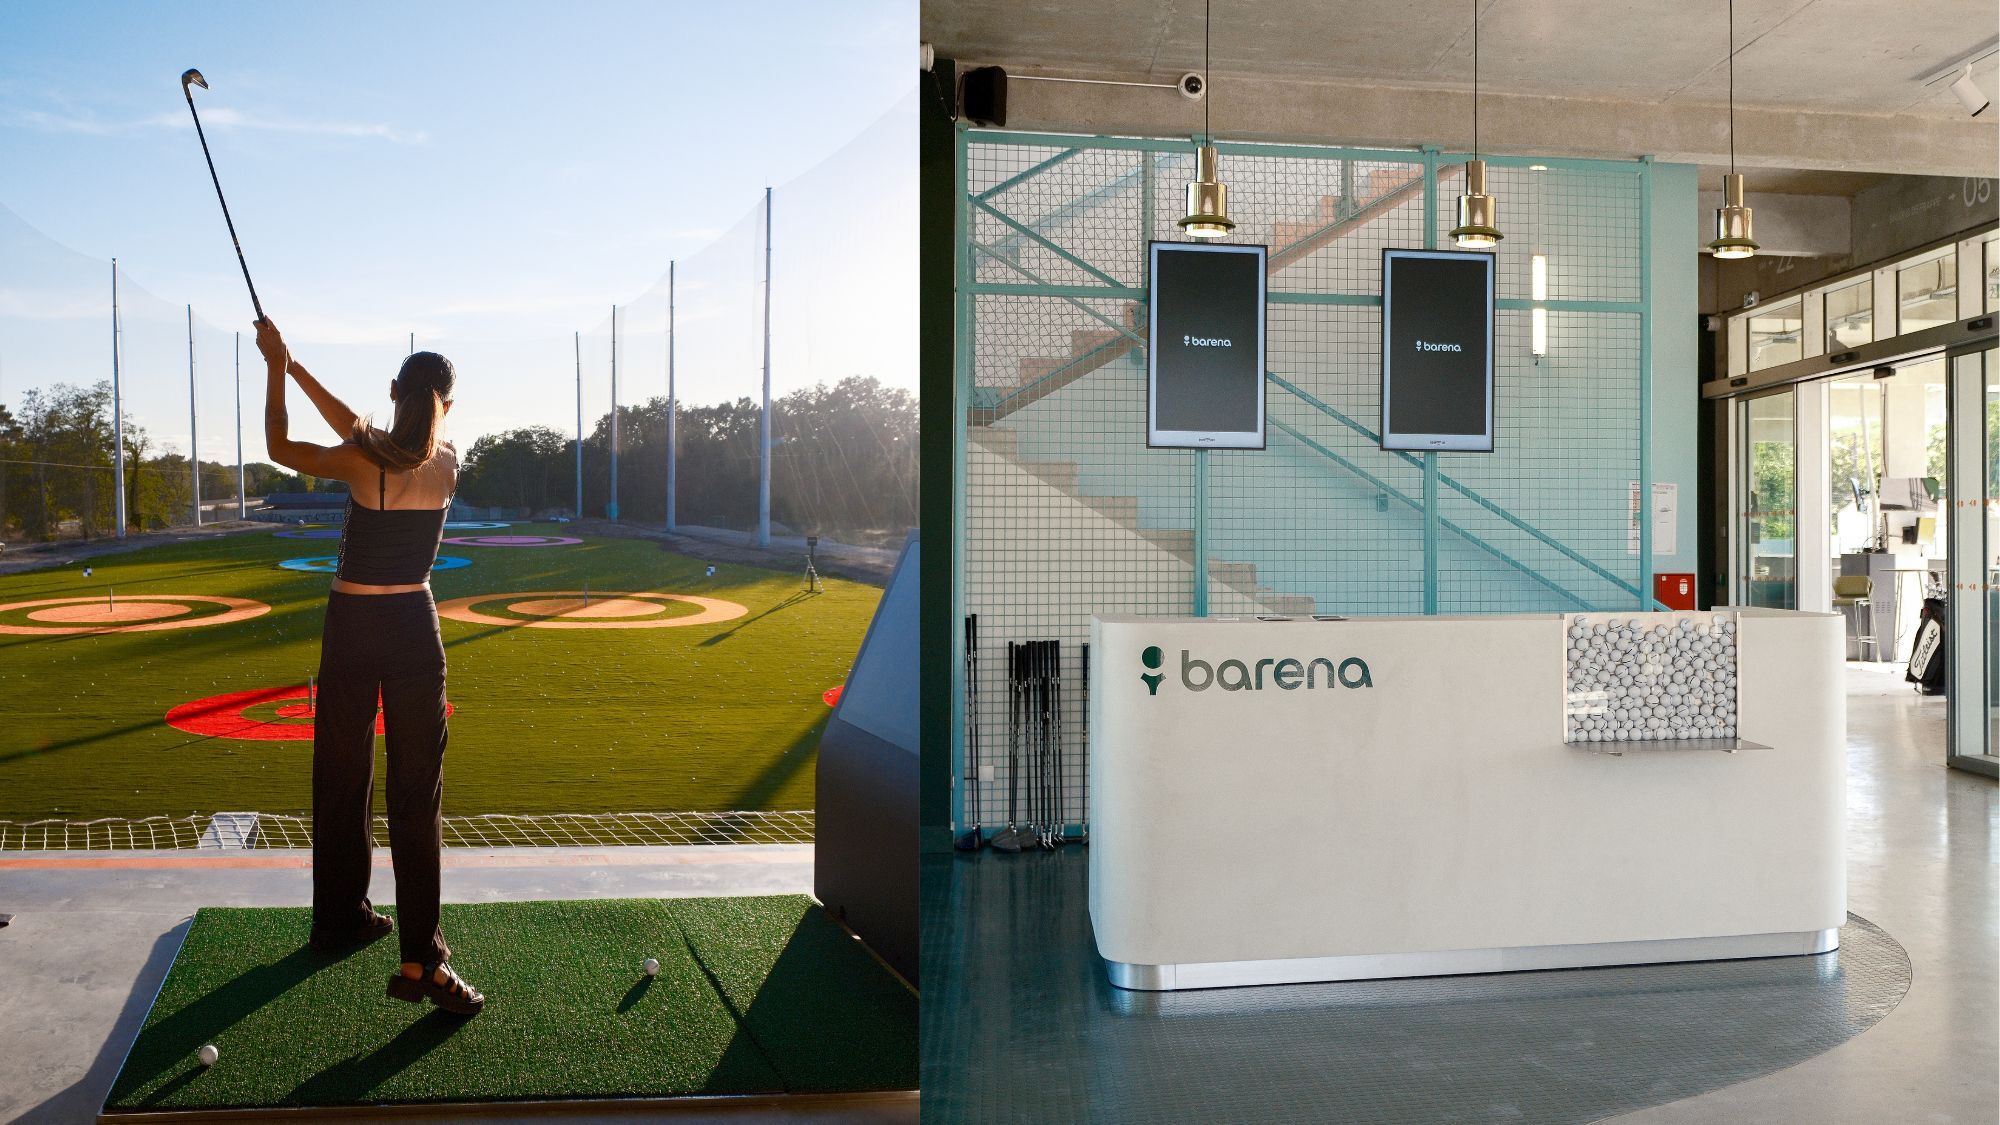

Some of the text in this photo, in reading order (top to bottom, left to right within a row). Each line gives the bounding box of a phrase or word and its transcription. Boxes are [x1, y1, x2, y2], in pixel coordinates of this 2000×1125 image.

[1191, 336, 1232, 347] barena
[1423, 341, 1462, 352] barena
[1914, 628, 1938, 677] Titleist
[1181, 649, 1374, 692] barena
